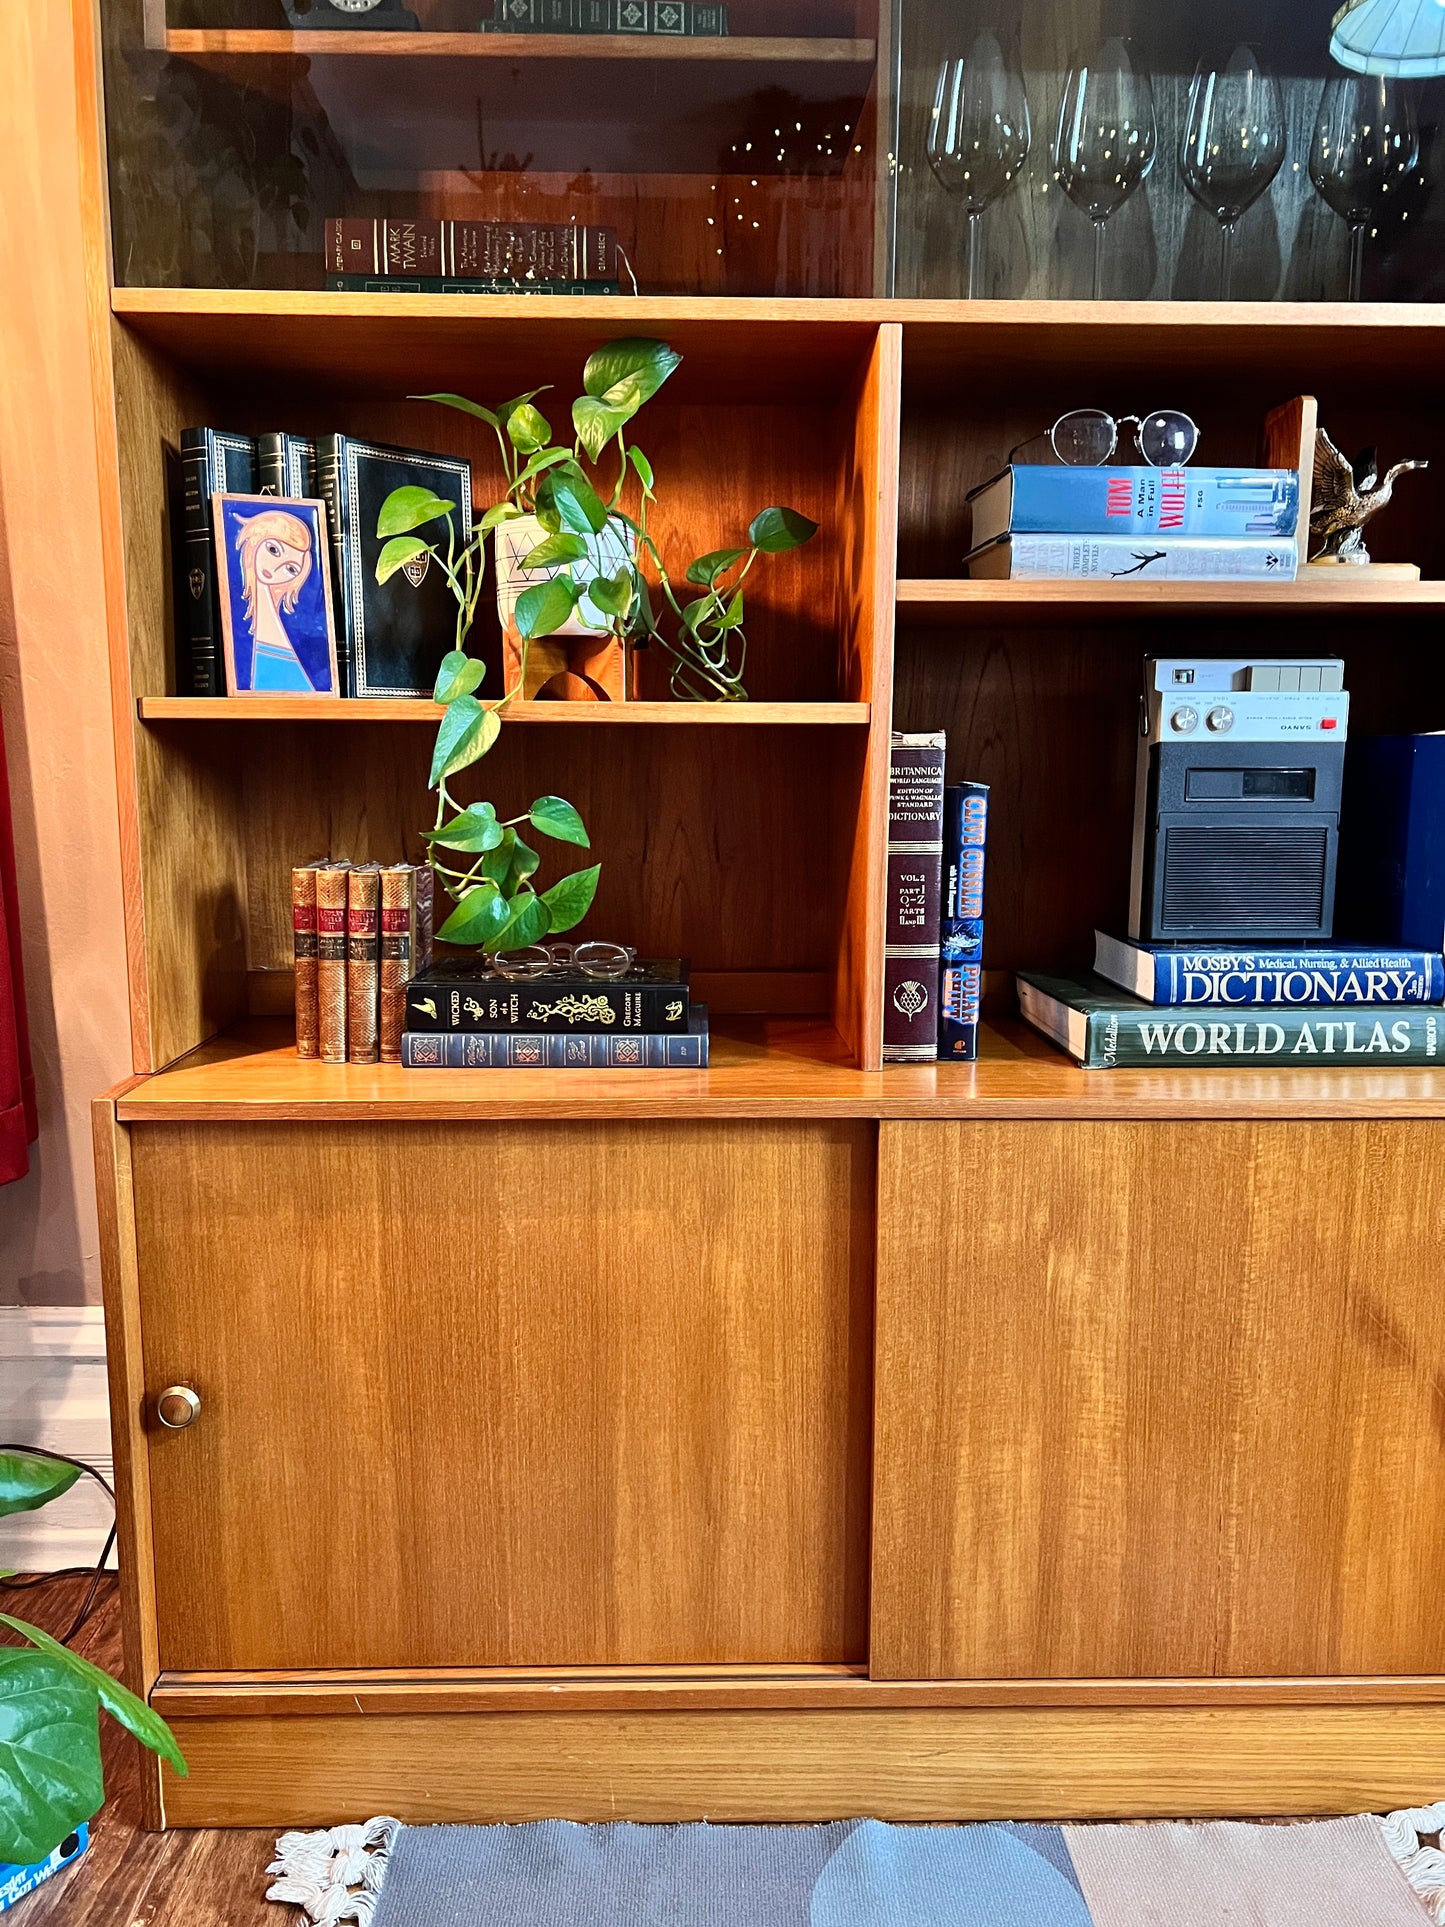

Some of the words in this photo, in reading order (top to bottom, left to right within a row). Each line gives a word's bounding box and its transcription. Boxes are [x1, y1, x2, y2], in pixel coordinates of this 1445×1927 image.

[389, 228, 401, 264] MARK
[403, 223, 417, 269] TWAIN
[1106, 478, 1133, 518] TOM
[1138, 479, 1146, 505] Man
[1158, 468, 1186, 529] WOLFE
[1137, 508, 1144, 518] A
[1147, 506, 1154, 518] in
[1072, 546, 1081, 570] THREE
[1090, 544, 1100, 573] NOVELS
[889, 766, 943, 776] BRITANNICA
[889, 811, 942, 821] DICTIONARY
[962, 798, 986, 845] CLIVE
[919, 874, 926, 882] 2
[959, 849, 985, 919] CUSSLER
[1182, 955, 1256, 972] MOSBY'S
[1259, 958, 1298, 970] Medical,
[1300, 958, 1338, 971] Nursing,
[1339, 960, 1350, 969] &
[1351, 957, 1380, 969] Allied
[1381, 957, 1412, 969] Health
[943, 970, 961, 1019] SHIFT
[960, 966, 980, 1024] POLAR
[1182, 971, 1417, 1003] DICTIONARY
[451, 990, 460, 1026] WICKED
[489, 998, 498, 1019] SON
[500, 1007, 508, 1015] of
[510, 993, 519, 1024] WITCH
[623, 991, 632, 1027] GREGORY
[634, 991, 642, 1027] MAGUIRE
[1104, 1014, 1119, 1066] Medallion
[1137, 1022, 1293, 1056] WORLD
[1291, 1020, 1412, 1055] ATLAS
